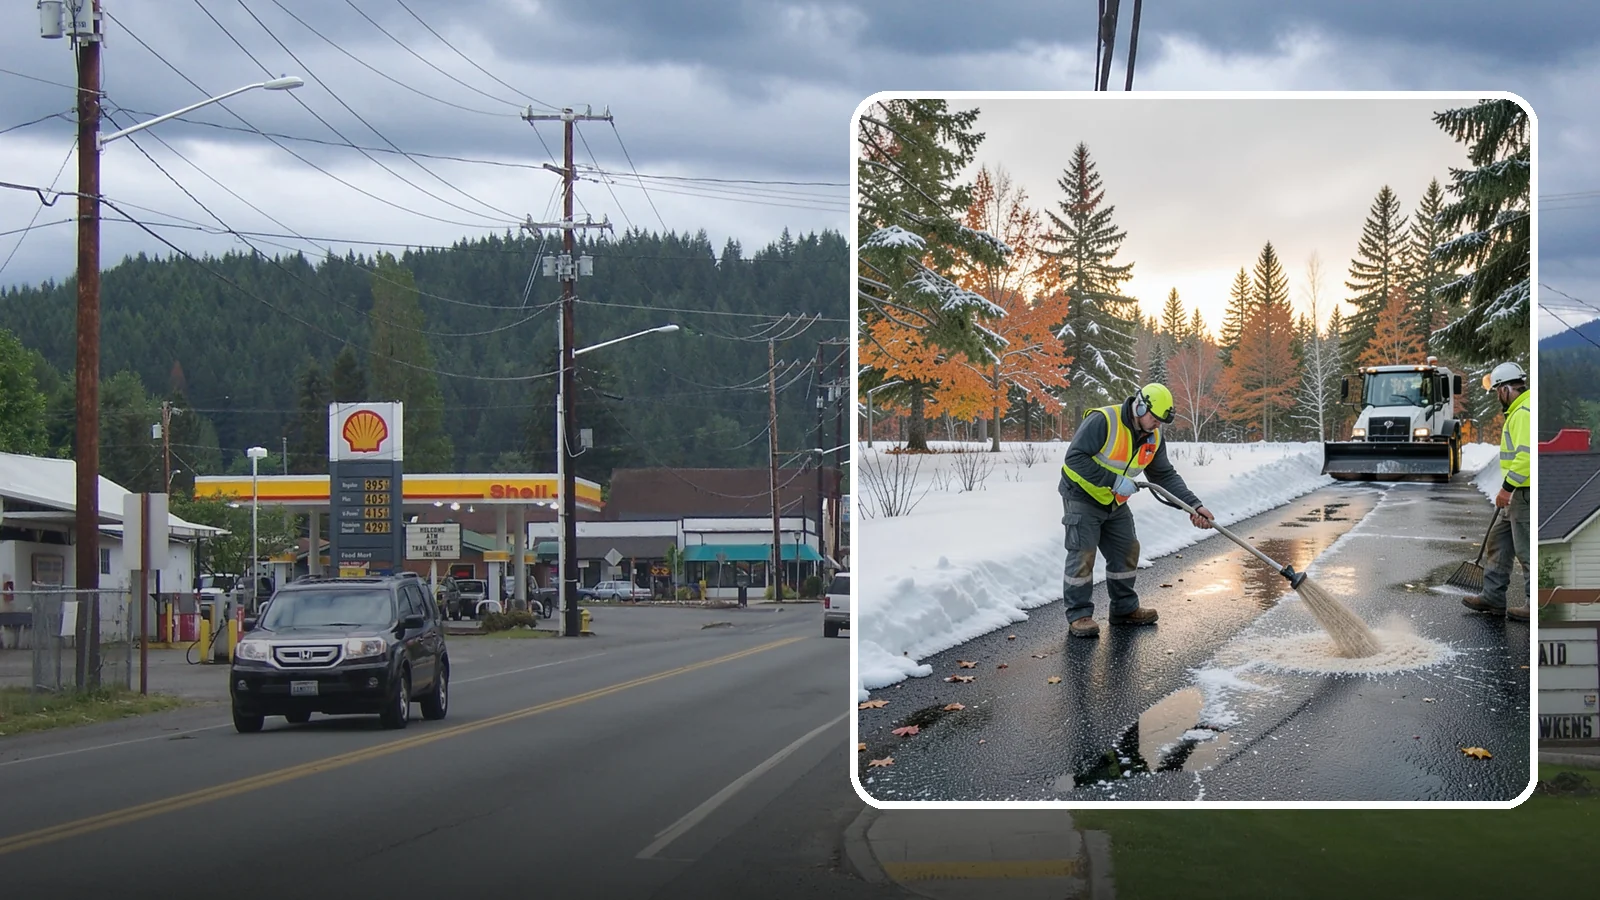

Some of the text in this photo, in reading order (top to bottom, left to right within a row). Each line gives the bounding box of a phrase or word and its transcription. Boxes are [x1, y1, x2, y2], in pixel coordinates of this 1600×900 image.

[365, 480, 384, 490] 395
[490, 484, 547, 499] Shell
[365, 494, 384, 504] 405
[365, 508, 384, 518] 415
[365, 522, 384, 533] 429
